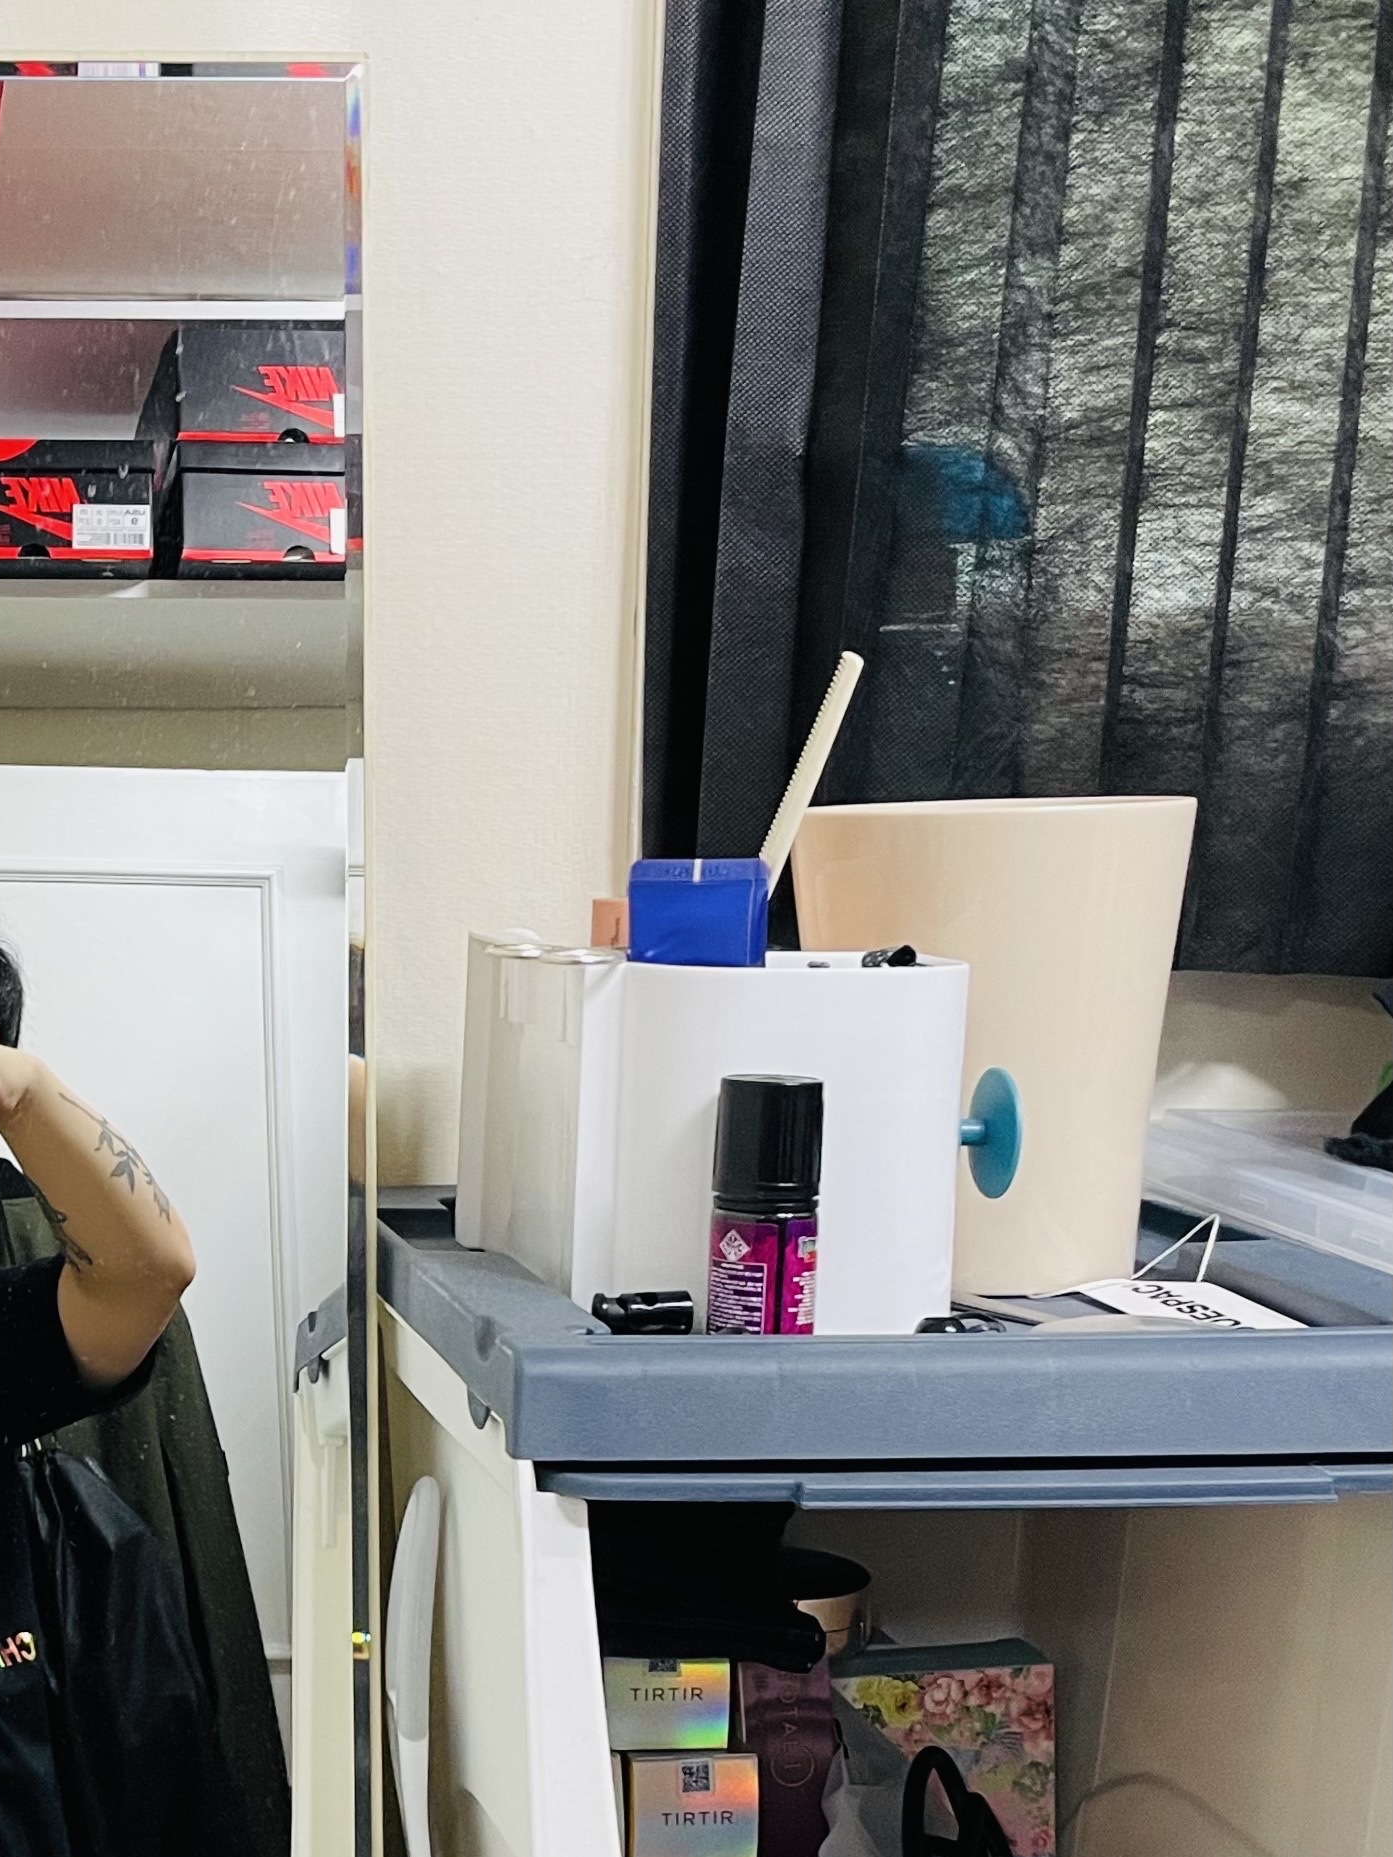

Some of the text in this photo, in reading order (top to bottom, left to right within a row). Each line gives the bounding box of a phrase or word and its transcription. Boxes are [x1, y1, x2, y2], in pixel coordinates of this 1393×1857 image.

[1130, 1284, 1256, 1330] UESPAC
[629, 1686, 704, 1703] TIRTIR
[661, 1810, 734, 1828] TIRTIR
